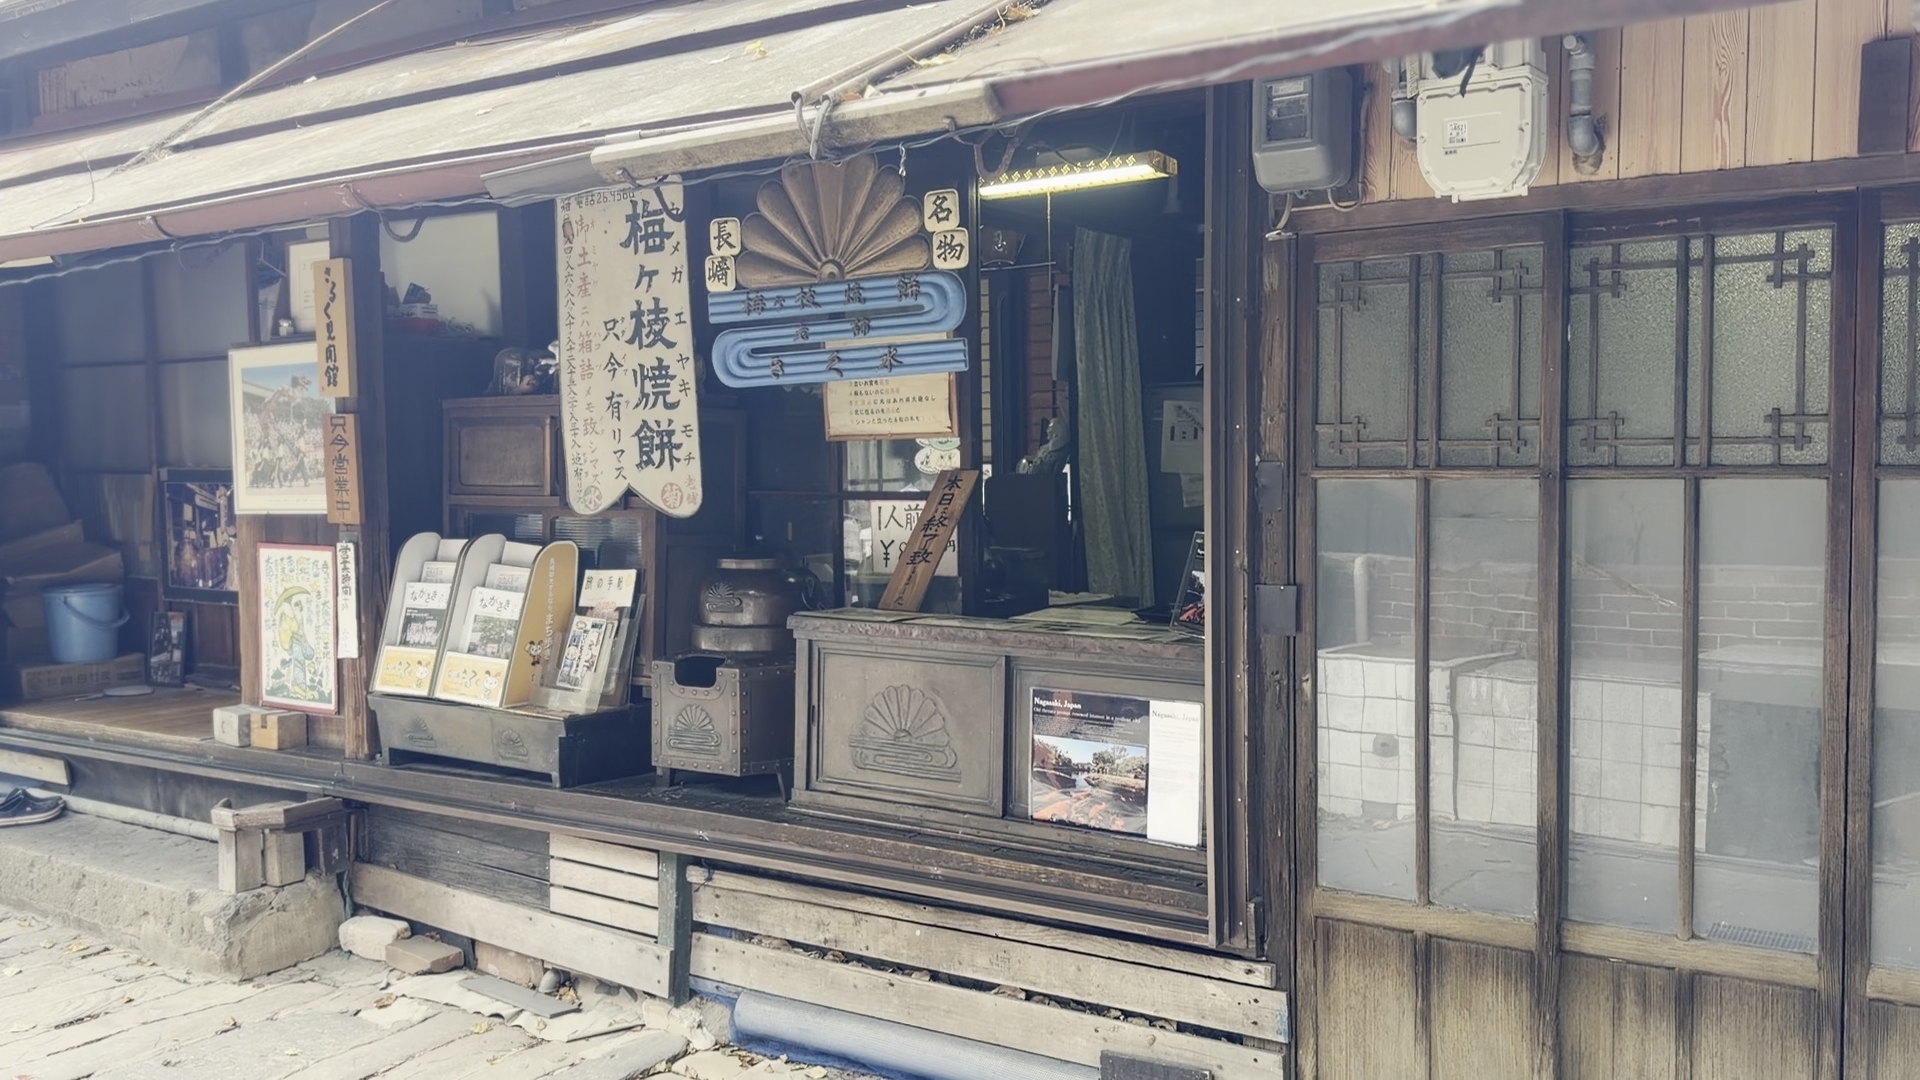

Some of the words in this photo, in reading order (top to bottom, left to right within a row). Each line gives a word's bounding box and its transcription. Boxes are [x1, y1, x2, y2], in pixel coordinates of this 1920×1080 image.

[927, 194, 966, 263] 名物
[329, 414, 351, 521] 只今営業中
[1034, 696, 1063, 709] Nagasaki,
[1063, 701, 1082, 711] Japan
